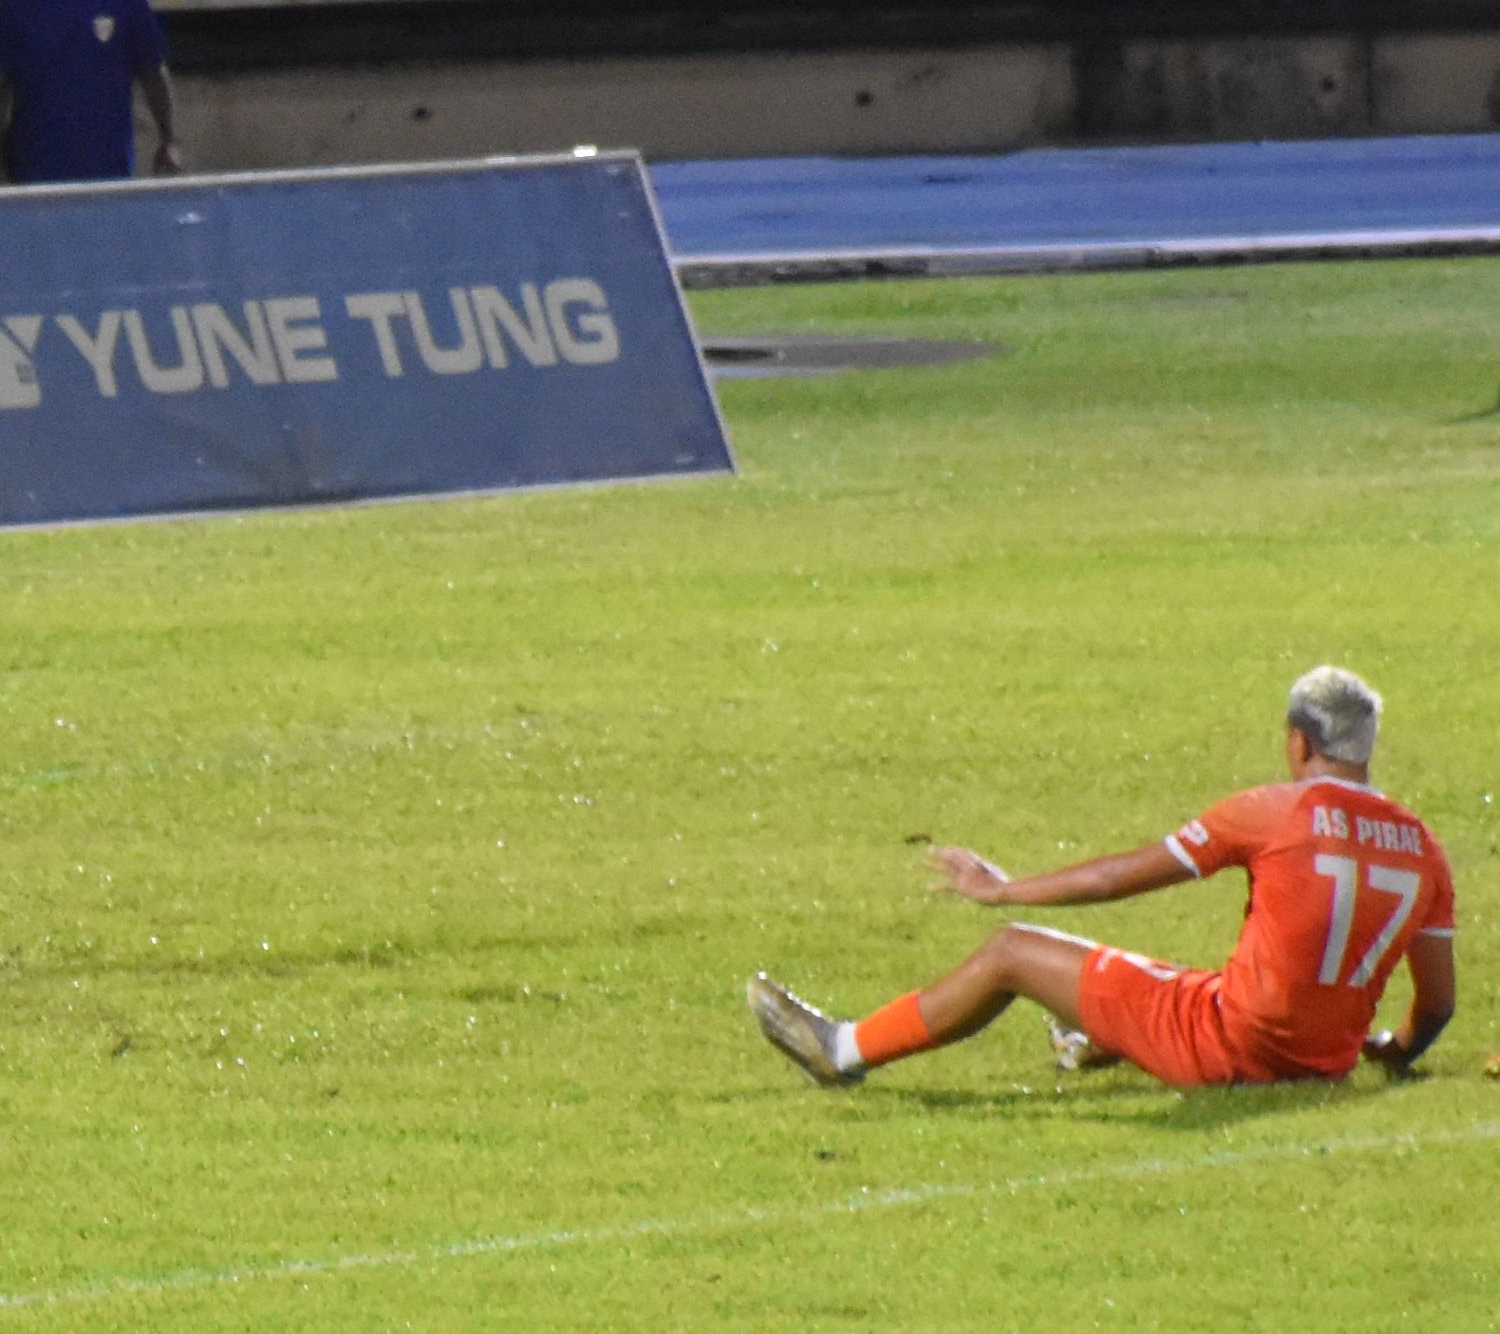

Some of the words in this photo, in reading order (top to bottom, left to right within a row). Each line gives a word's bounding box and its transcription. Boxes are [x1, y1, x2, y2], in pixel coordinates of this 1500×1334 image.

[54, 296, 338, 398] YUNE
[344, 277, 621, 378] TUNG
[1312, 805, 1349, 840] AS
[1313, 853, 1422, 988] 17
